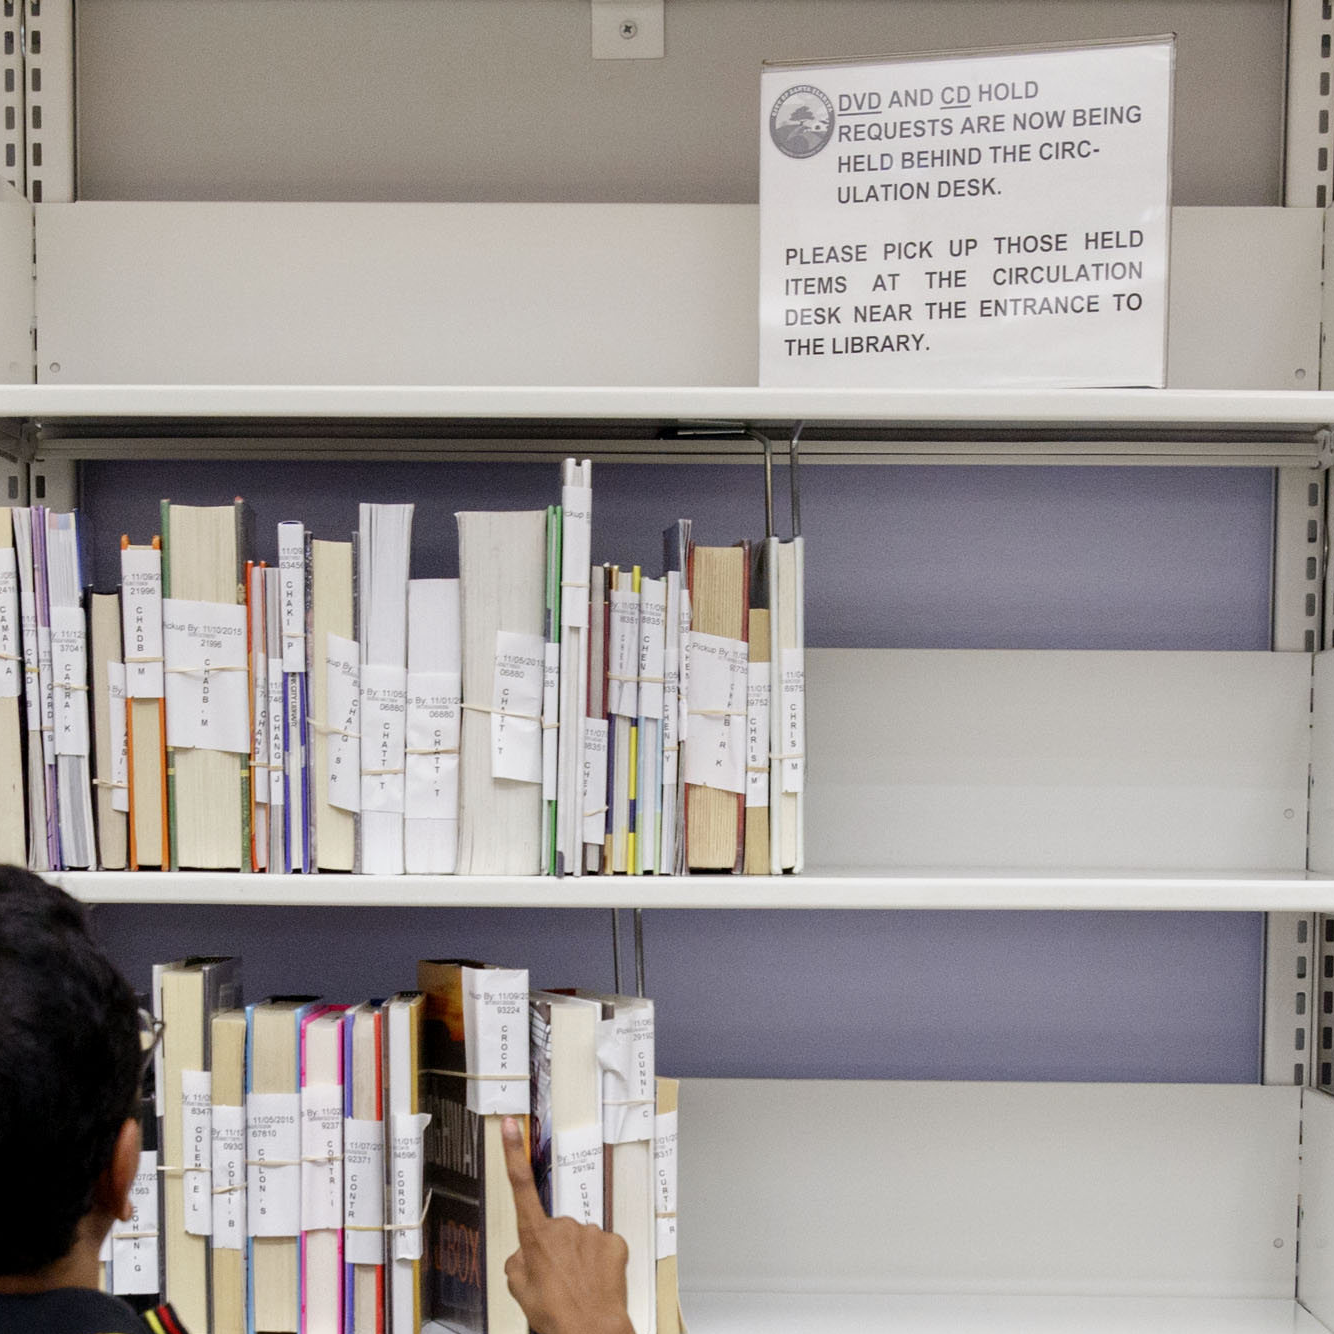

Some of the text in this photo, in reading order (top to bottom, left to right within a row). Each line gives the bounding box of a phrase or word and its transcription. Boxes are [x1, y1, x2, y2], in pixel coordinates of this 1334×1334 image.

[838, 92, 881, 112] DVD
[888, 89, 933, 109] AND
[940, 86, 971, 105] CD
[978, 81, 1038, 103] HOLD
[838, 106, 1142, 142] REQUESTS ARE NOW BEING
[838, 140, 1100, 173] HELD BEHIND THE CIRC-
[838, 177, 1002, 204] ULATION DESK.
[785, 230, 1144, 265] PLEASE PICK UP THOSE HELD
[785, 262, 1143, 296] ITEMS AT THE CIRCULATION
[785, 293, 1142, 326] DESK NEAR THE ENTRANCE TO
[785, 334, 930, 356] THE LIBRARY.
[130, 587, 155, 595] 21996
[497, 1006, 520, 1014] 93224
[253, 1116, 294, 1124] 11/05/2015
